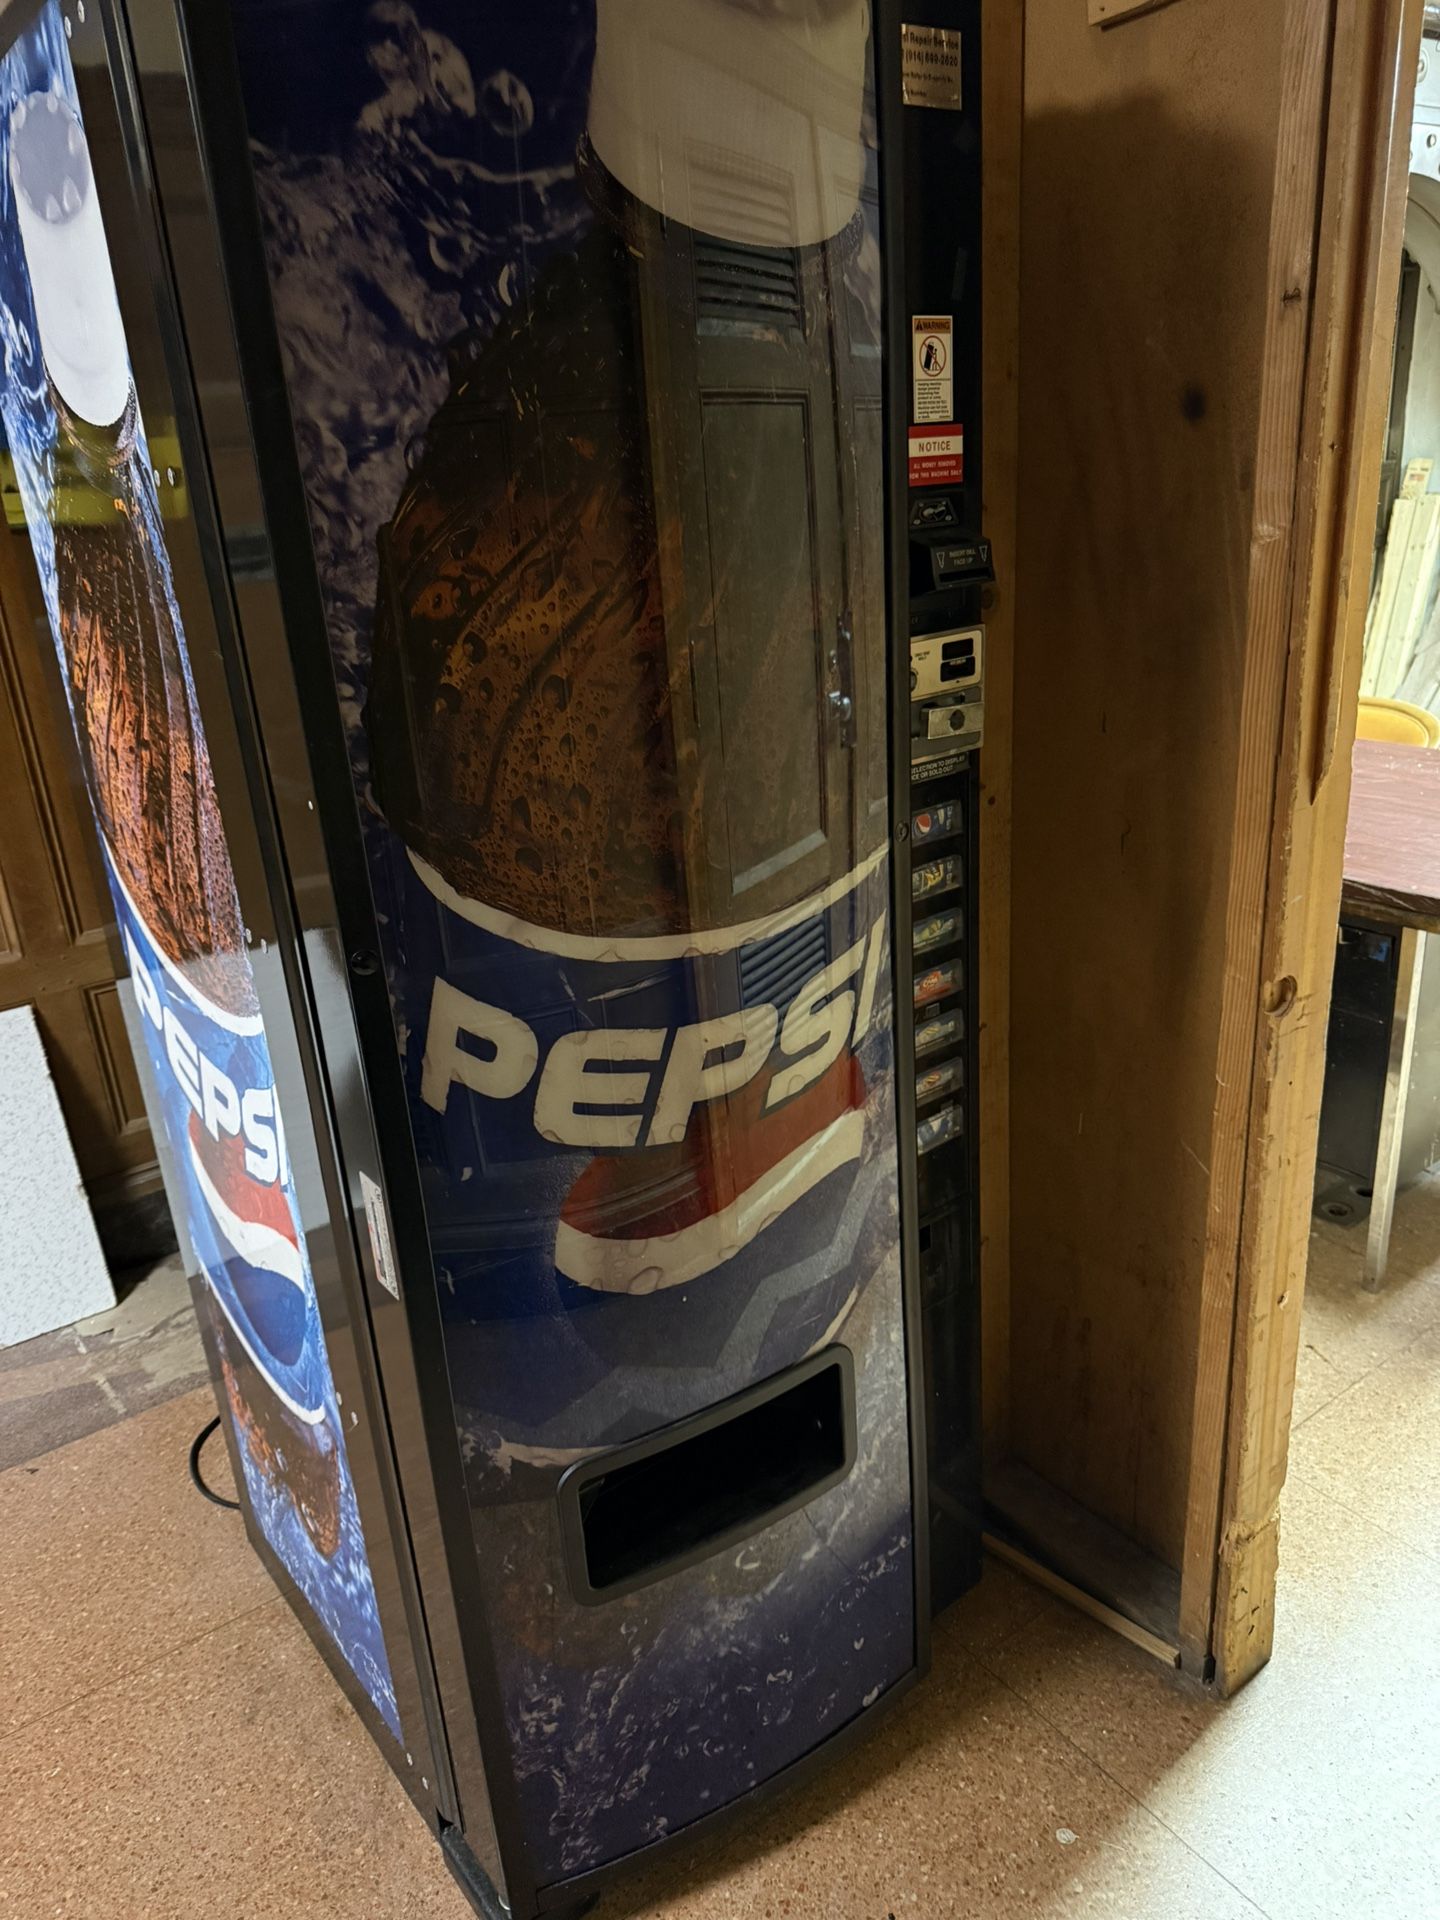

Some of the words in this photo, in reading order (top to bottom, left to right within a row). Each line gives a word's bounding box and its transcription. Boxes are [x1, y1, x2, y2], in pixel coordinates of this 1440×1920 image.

[922, 321, 950, 330] WARNING
[918, 440, 951, 453] NOTICE
[420, 908, 887, 1149] PEPSI
